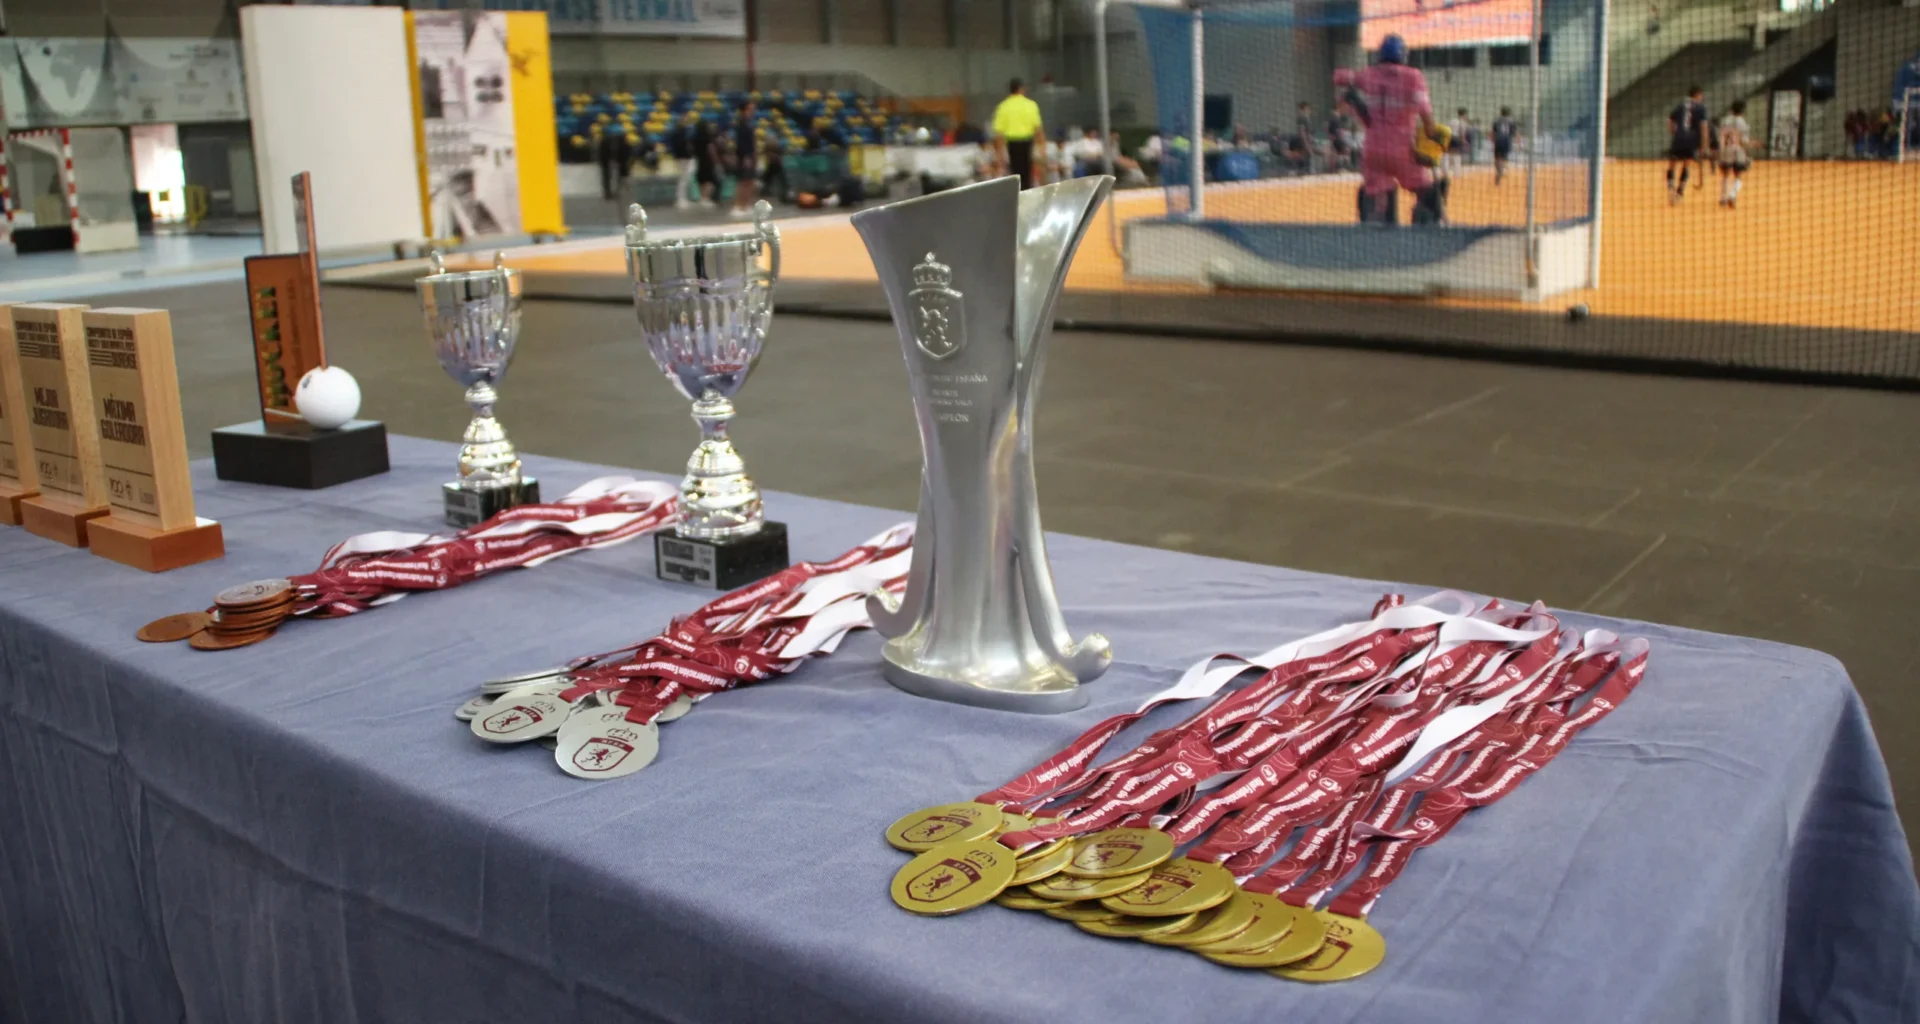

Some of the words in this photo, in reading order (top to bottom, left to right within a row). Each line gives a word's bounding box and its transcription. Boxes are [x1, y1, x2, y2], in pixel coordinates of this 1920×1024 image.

[649, 661, 679, 674] Española
[677, 666, 714, 685] Federación
[1035, 765, 1063, 784] Hockey
[1057, 760, 1071, 775] de
[1158, 772, 1179, 789] Real
[1247, 774, 1265, 792] Real
[1177, 814, 1205, 834] Hockey
